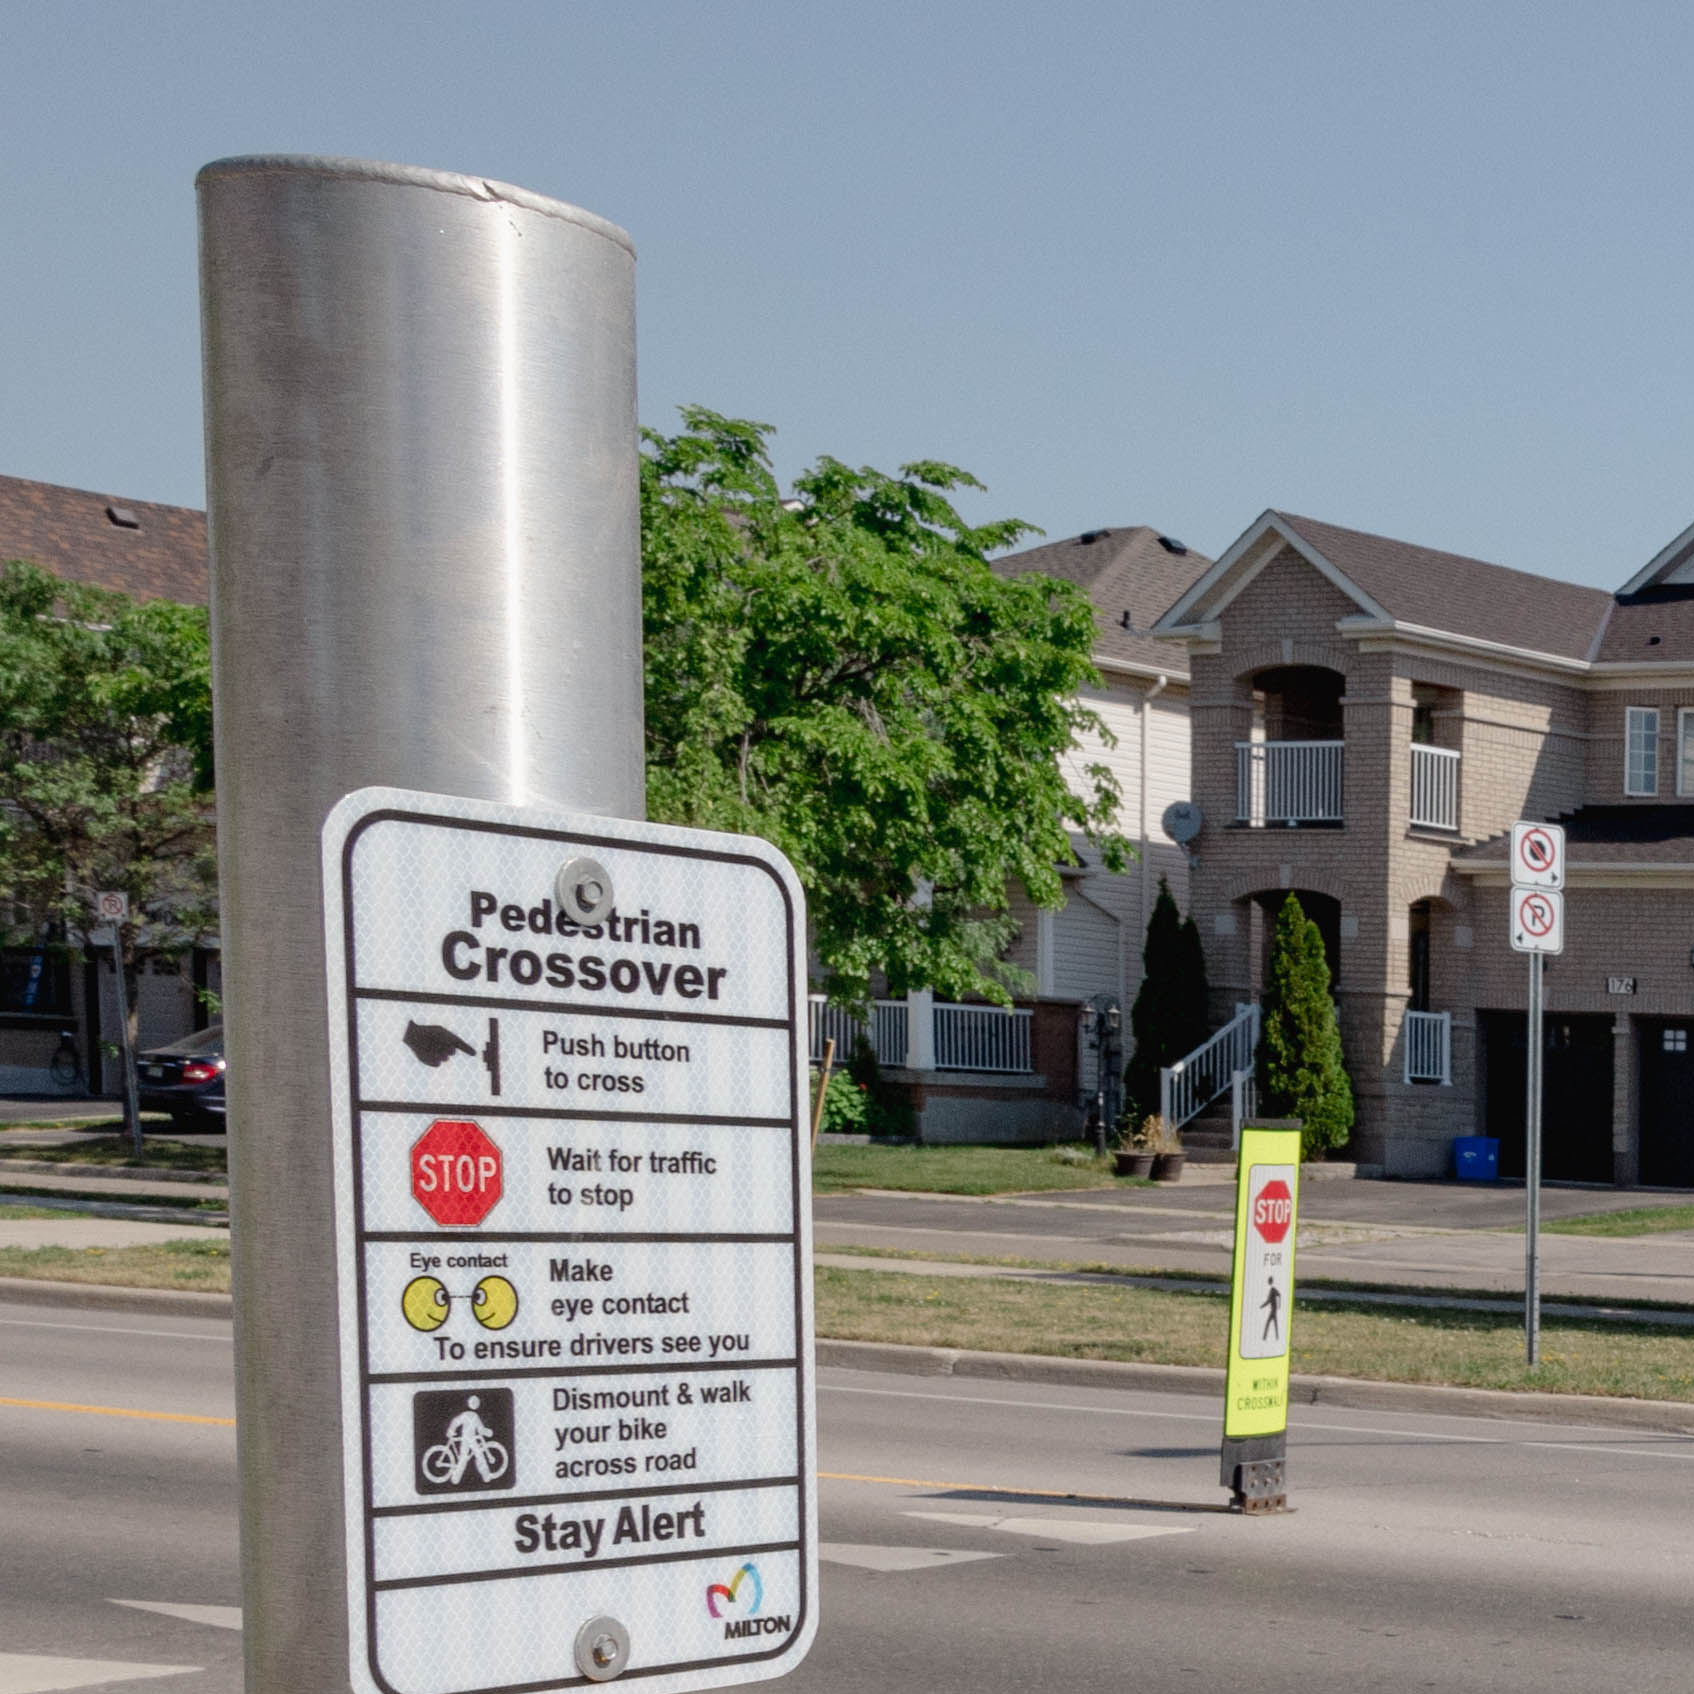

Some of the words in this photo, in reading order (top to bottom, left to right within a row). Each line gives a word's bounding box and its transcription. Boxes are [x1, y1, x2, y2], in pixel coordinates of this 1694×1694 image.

[441, 930, 728, 1000] Crossover
[543, 1030, 605, 1058] Push
[614, 1035, 691, 1062] button
[545, 1069, 568, 1089] to
[577, 1074, 645, 1093] cross
[419, 1154, 497, 1192] STOP
[547, 1147, 601, 1172] Wait
[608, 1150, 642, 1173] for
[650, 1152, 717, 1175] traffic
[548, 1185, 571, 1205] to
[581, 1185, 633, 1211] stop
[1255, 1199, 1292, 1224] STOP
[410, 1253, 441, 1272] Eye
[447, 1253, 508, 1268] contact
[550, 1259, 613, 1282] Make
[1263, 1252, 1282, 1266] FOR
[551, 1297, 593, 1321] eye
[602, 1293, 690, 1315] contact
[434, 1337, 465, 1360] To
[474, 1339, 562, 1359] ensure
[570, 1333, 653, 1356] drivers
[662, 1336, 702, 1352] see
[708, 1334, 750, 1357] you
[553, 1387, 670, 1411] Dismount
[677, 1382, 694, 1405] &
[701, 1380, 752, 1404] walk
[555, 1424, 611, 1451] your
[619, 1419, 668, 1441] bike
[555, 1456, 637, 1479] across
[645, 1447, 697, 1473] road
[515, 1513, 605, 1558] Stay
[612, 1501, 706, 1545] Alert
[724, 1615, 791, 1640] MILTON
